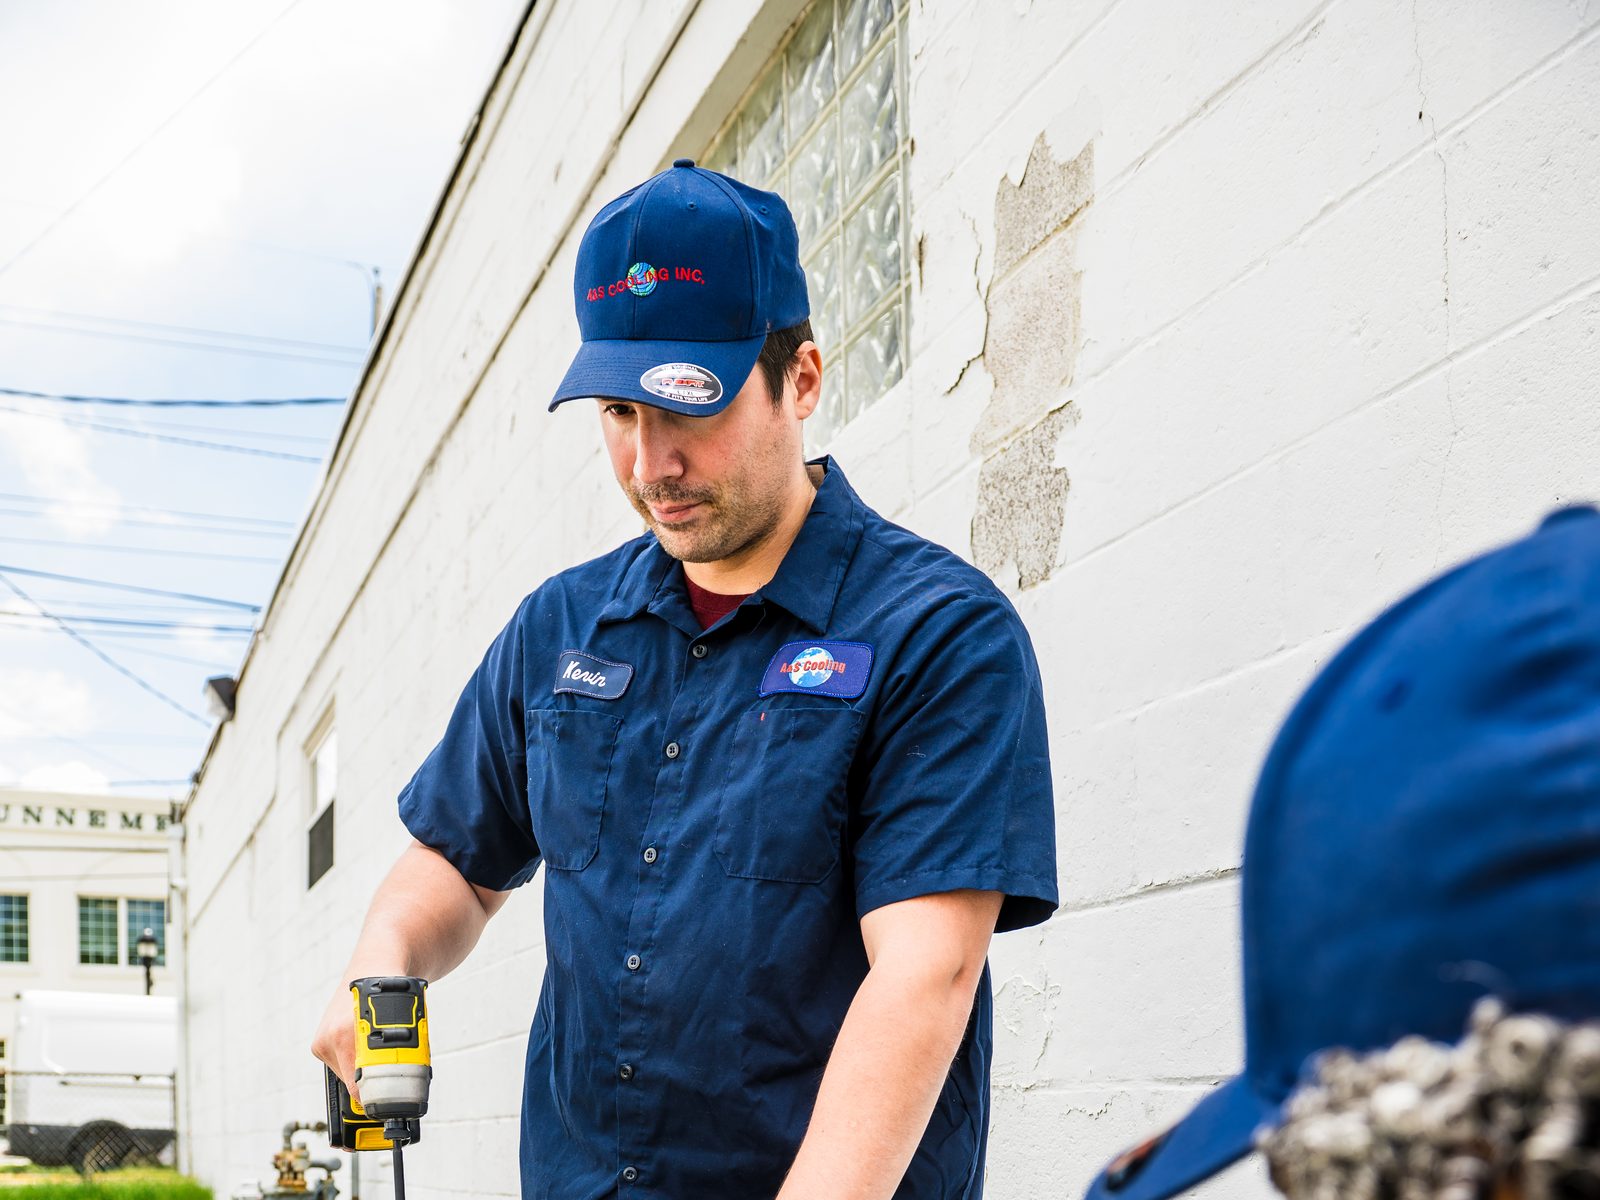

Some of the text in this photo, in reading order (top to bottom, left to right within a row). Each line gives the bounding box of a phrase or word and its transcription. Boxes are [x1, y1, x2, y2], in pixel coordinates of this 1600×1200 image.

[607, 267, 670, 297] COOLING
[562, 660, 606, 687] Kevin
[803, 659, 846, 673] Cooling
